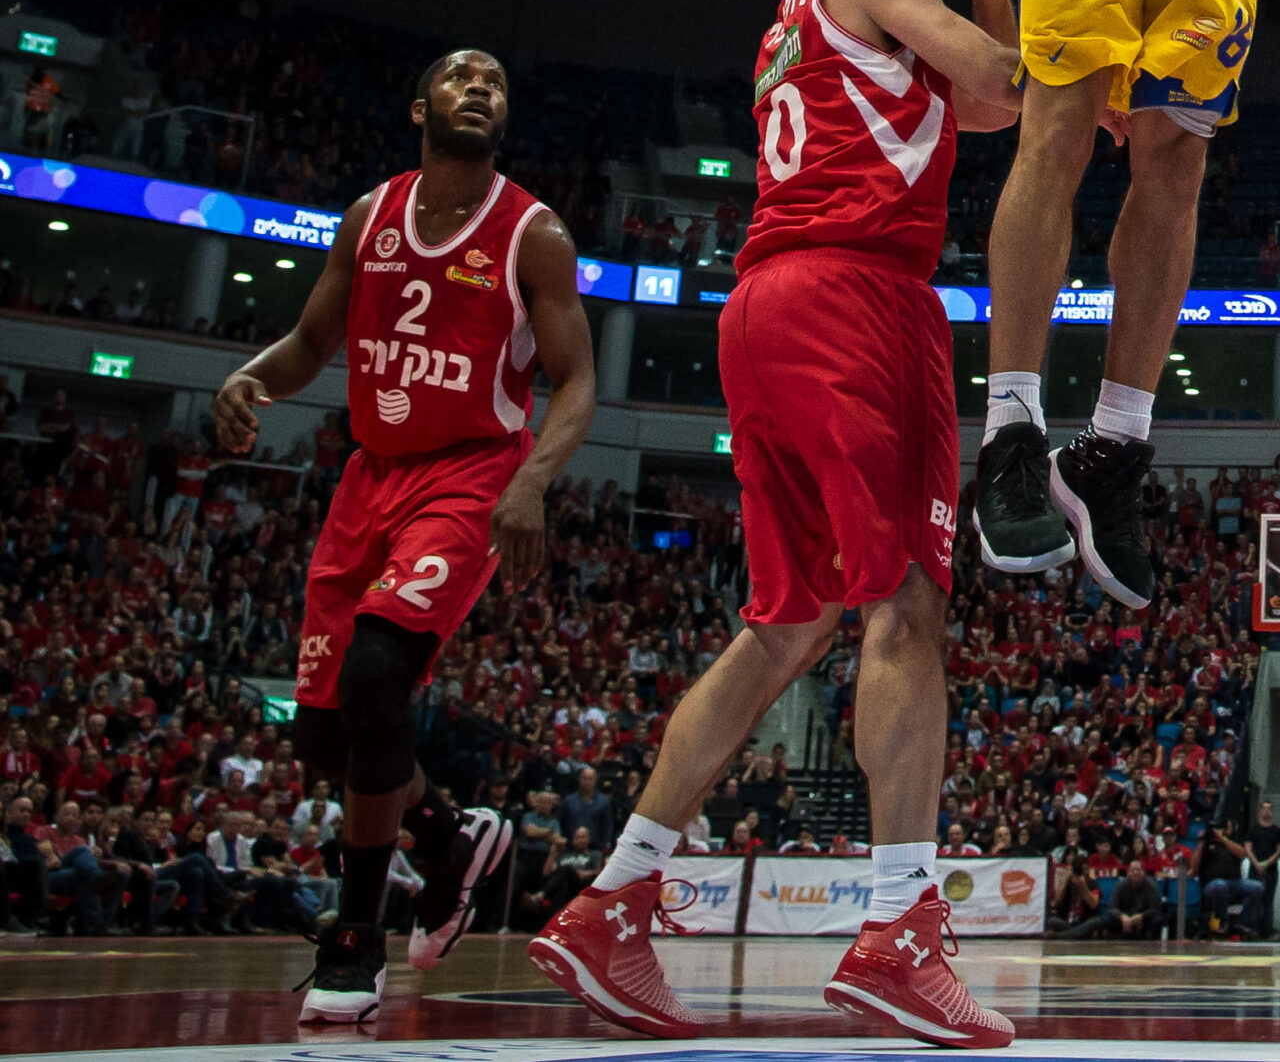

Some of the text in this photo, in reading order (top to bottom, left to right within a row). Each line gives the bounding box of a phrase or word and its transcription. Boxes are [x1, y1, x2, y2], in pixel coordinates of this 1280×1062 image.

[764, 82, 807, 182] 0
[394, 279, 432, 336] 2
[644, 275, 674, 297] 11
[1224, 300, 1266, 314] מכבי
[400, 342, 473, 393] בנק
[396, 555, 449, 611] 2
